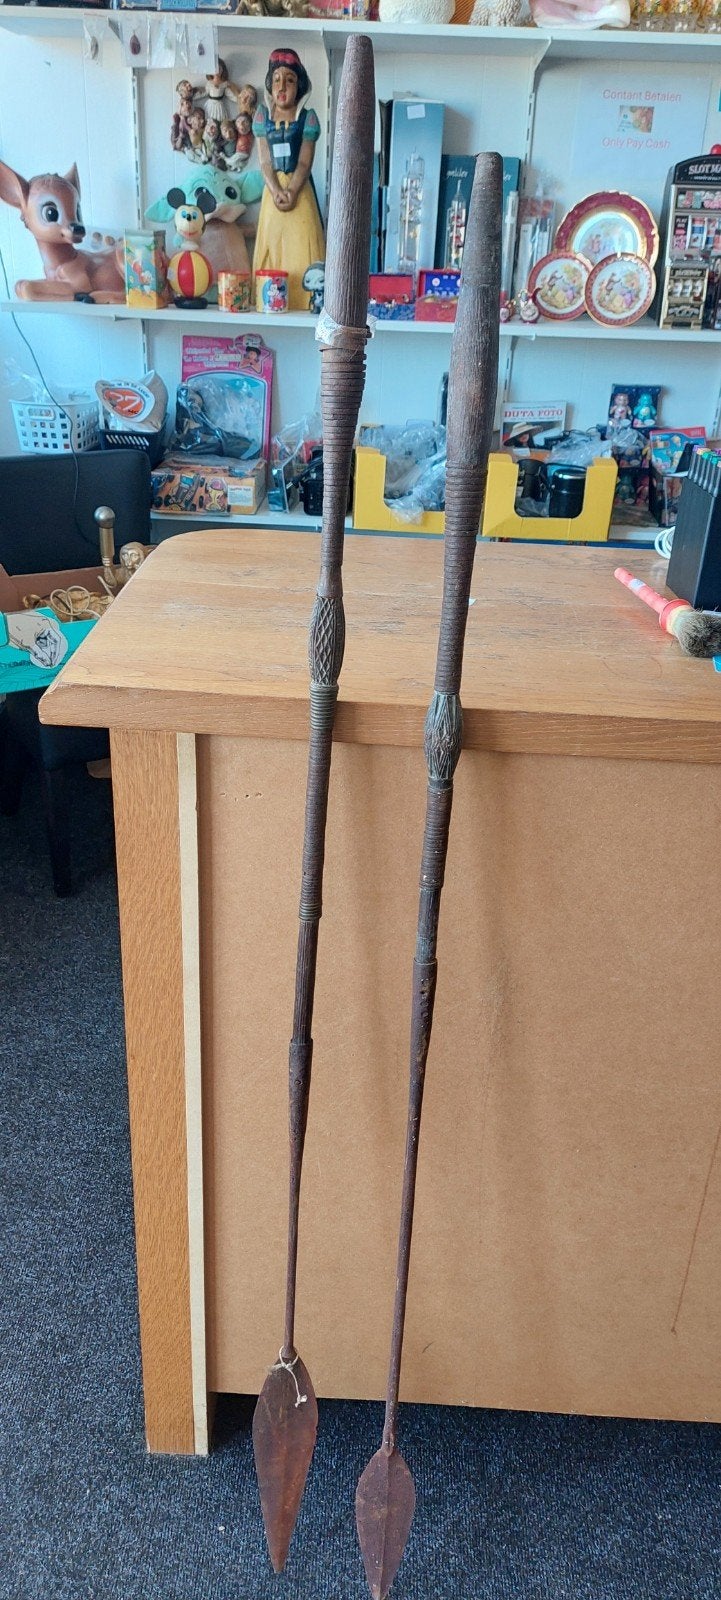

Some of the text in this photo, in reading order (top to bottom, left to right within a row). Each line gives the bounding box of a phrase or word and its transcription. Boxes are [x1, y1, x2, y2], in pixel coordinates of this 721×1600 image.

[602, 89, 682, 101] Contant Betalen
[602, 137, 671, 149] Only Pay Cash
[688, 164, 709, 175] SLOT
[538, 409, 563, 417] FOTO
